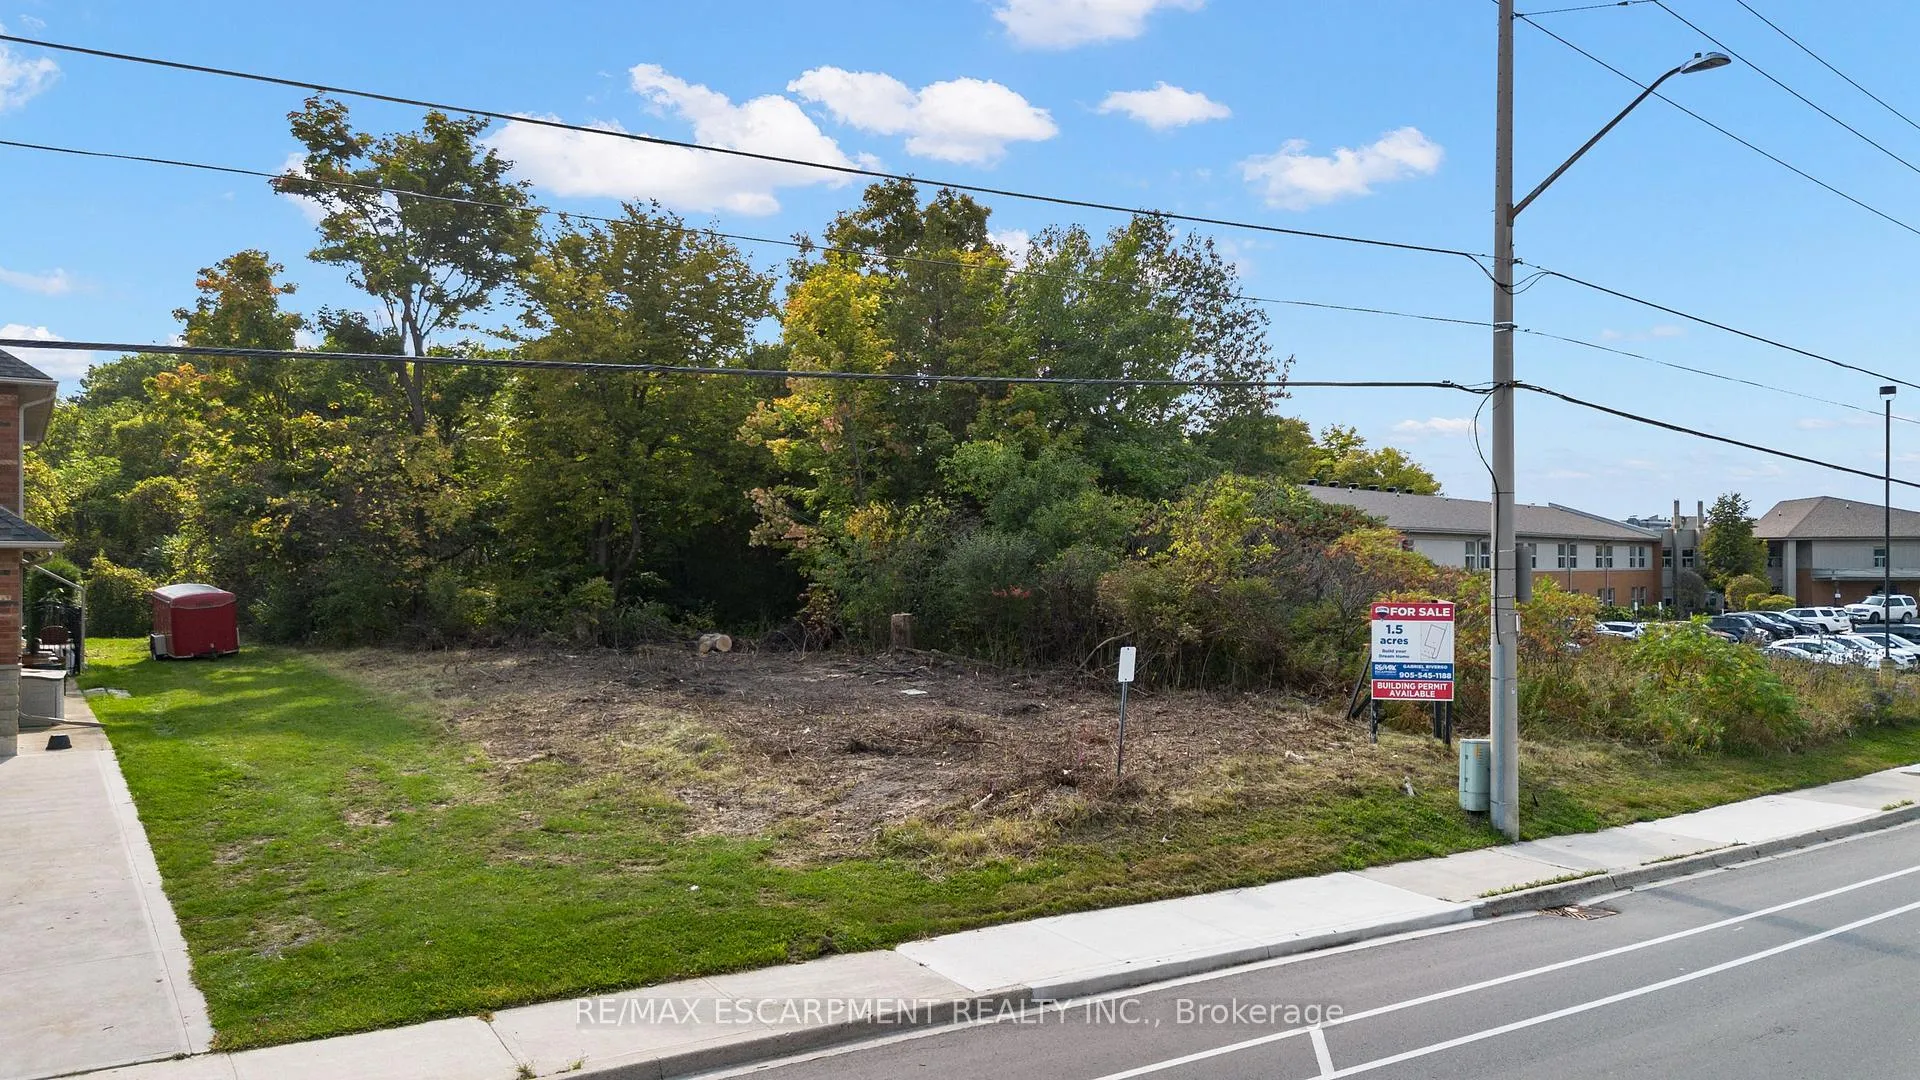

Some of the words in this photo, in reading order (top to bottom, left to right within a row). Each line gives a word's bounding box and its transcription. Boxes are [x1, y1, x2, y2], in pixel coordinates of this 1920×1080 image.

[1390, 607, 1416, 616] FOR
[1419, 607, 1450, 617] SALE
[1386, 624, 1403, 634] 1.5
[1399, 671, 1452, 679] 905-545-1188
[1377, 682, 1416, 690] BUILDING
[1417, 683, 1448, 691] PERMIT
[1389, 690, 1436, 698] AVAILABLE
